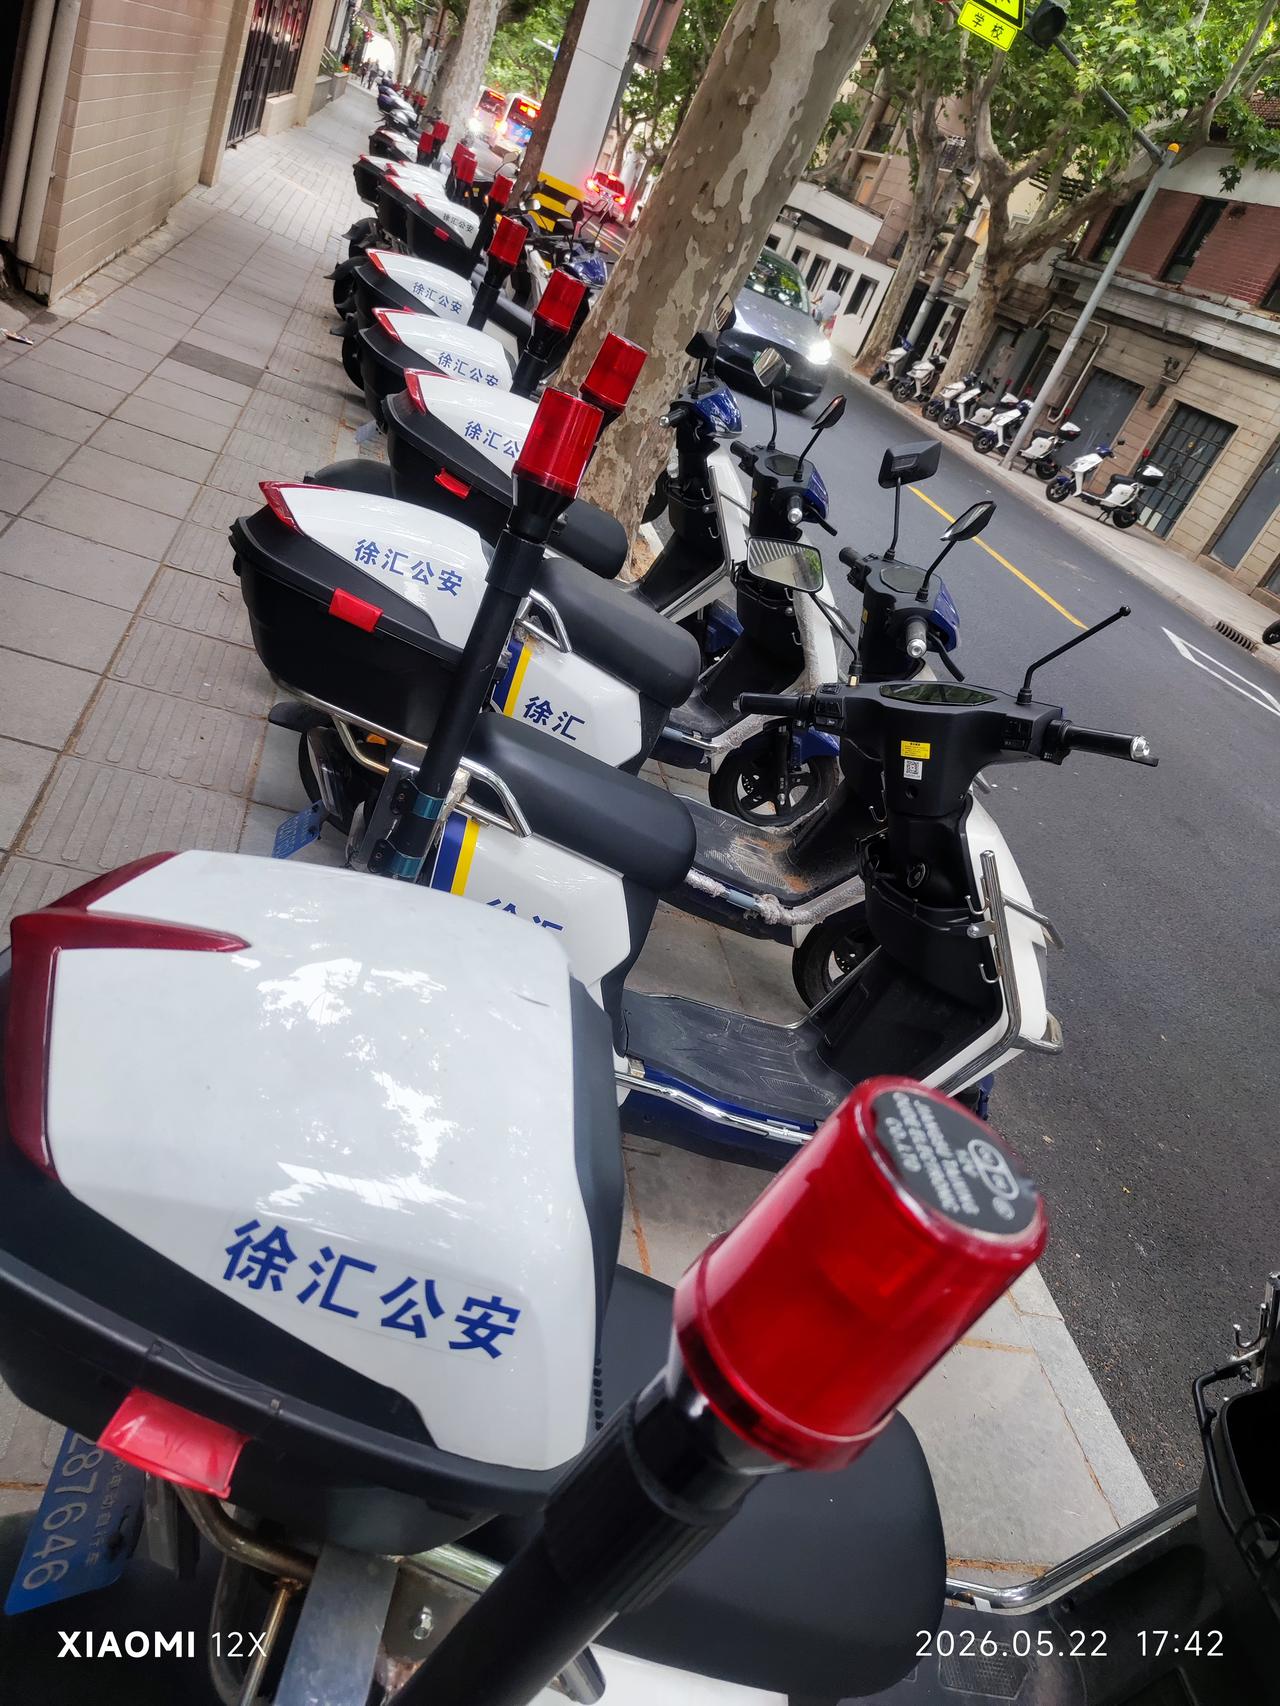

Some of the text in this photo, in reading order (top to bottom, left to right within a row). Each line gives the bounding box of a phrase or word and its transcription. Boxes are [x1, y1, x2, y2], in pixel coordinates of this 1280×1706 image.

[972, 13, 1005, 41] 学校
[412, 281, 462, 315] 徐汇公安
[437, 351, 499, 387] 徐汇公安
[354, 538, 463, 597] 徐汇公安
[522, 695, 586, 742] 徐汇
[222, 1218, 521, 1360] 徐汇公安
